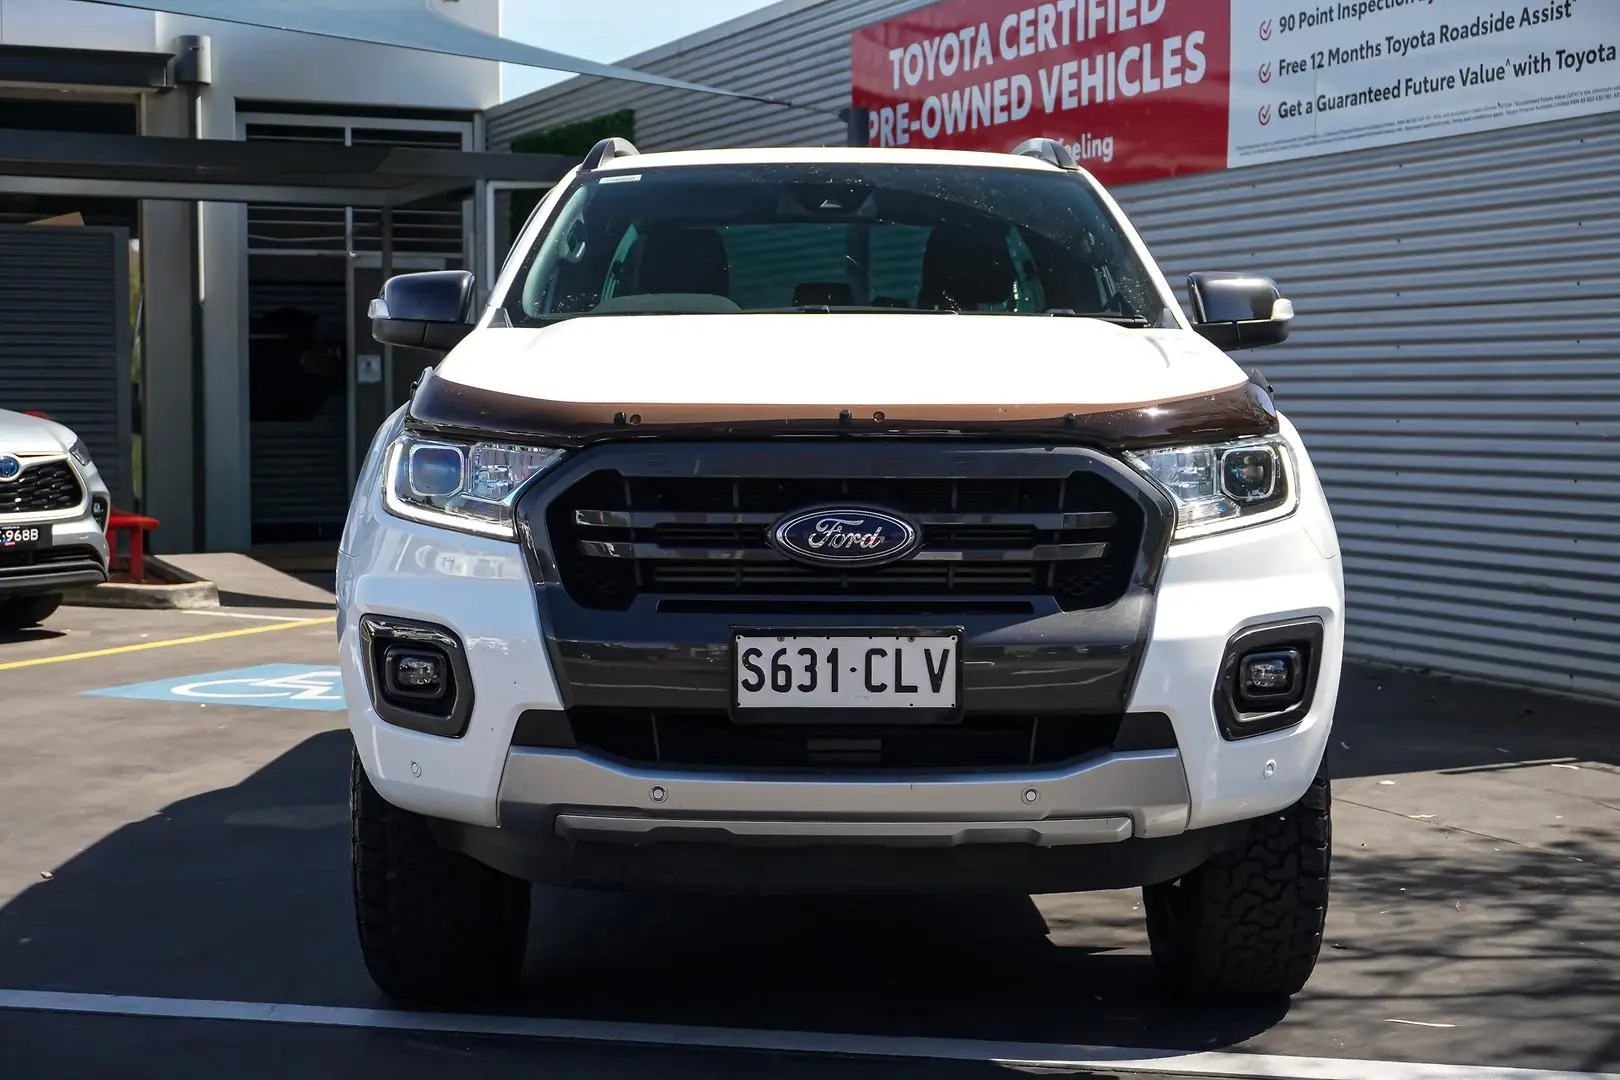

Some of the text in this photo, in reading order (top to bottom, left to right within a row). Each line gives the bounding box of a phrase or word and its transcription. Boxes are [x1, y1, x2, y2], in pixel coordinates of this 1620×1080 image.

[889, 0, 1167, 90] TOYOTA CERTIFIED
[1279, 15, 1296, 34] 90
[1299, 4, 1335, 29] Point
[1279, 57, 1307, 77] Free
[1310, 51, 1325, 71] 12
[1328, 40, 1382, 68] Months
[1385, 30, 1436, 57] Toyota
[1440, 11, 1516, 44] Roadside
[868, 30, 1207, 148] PRE-OWNED VEHICLES
[1278, 98, 1303, 119] Get
[1305, 100, 1314, 114] a
[1316, 79, 1402, 113] Guaranteed
[1405, 72, 1456, 97] Future
[1513, 50, 1552, 79] with
[1556, 43, 1617, 73] Toyota
[808, 517, 885, 549] Ford
